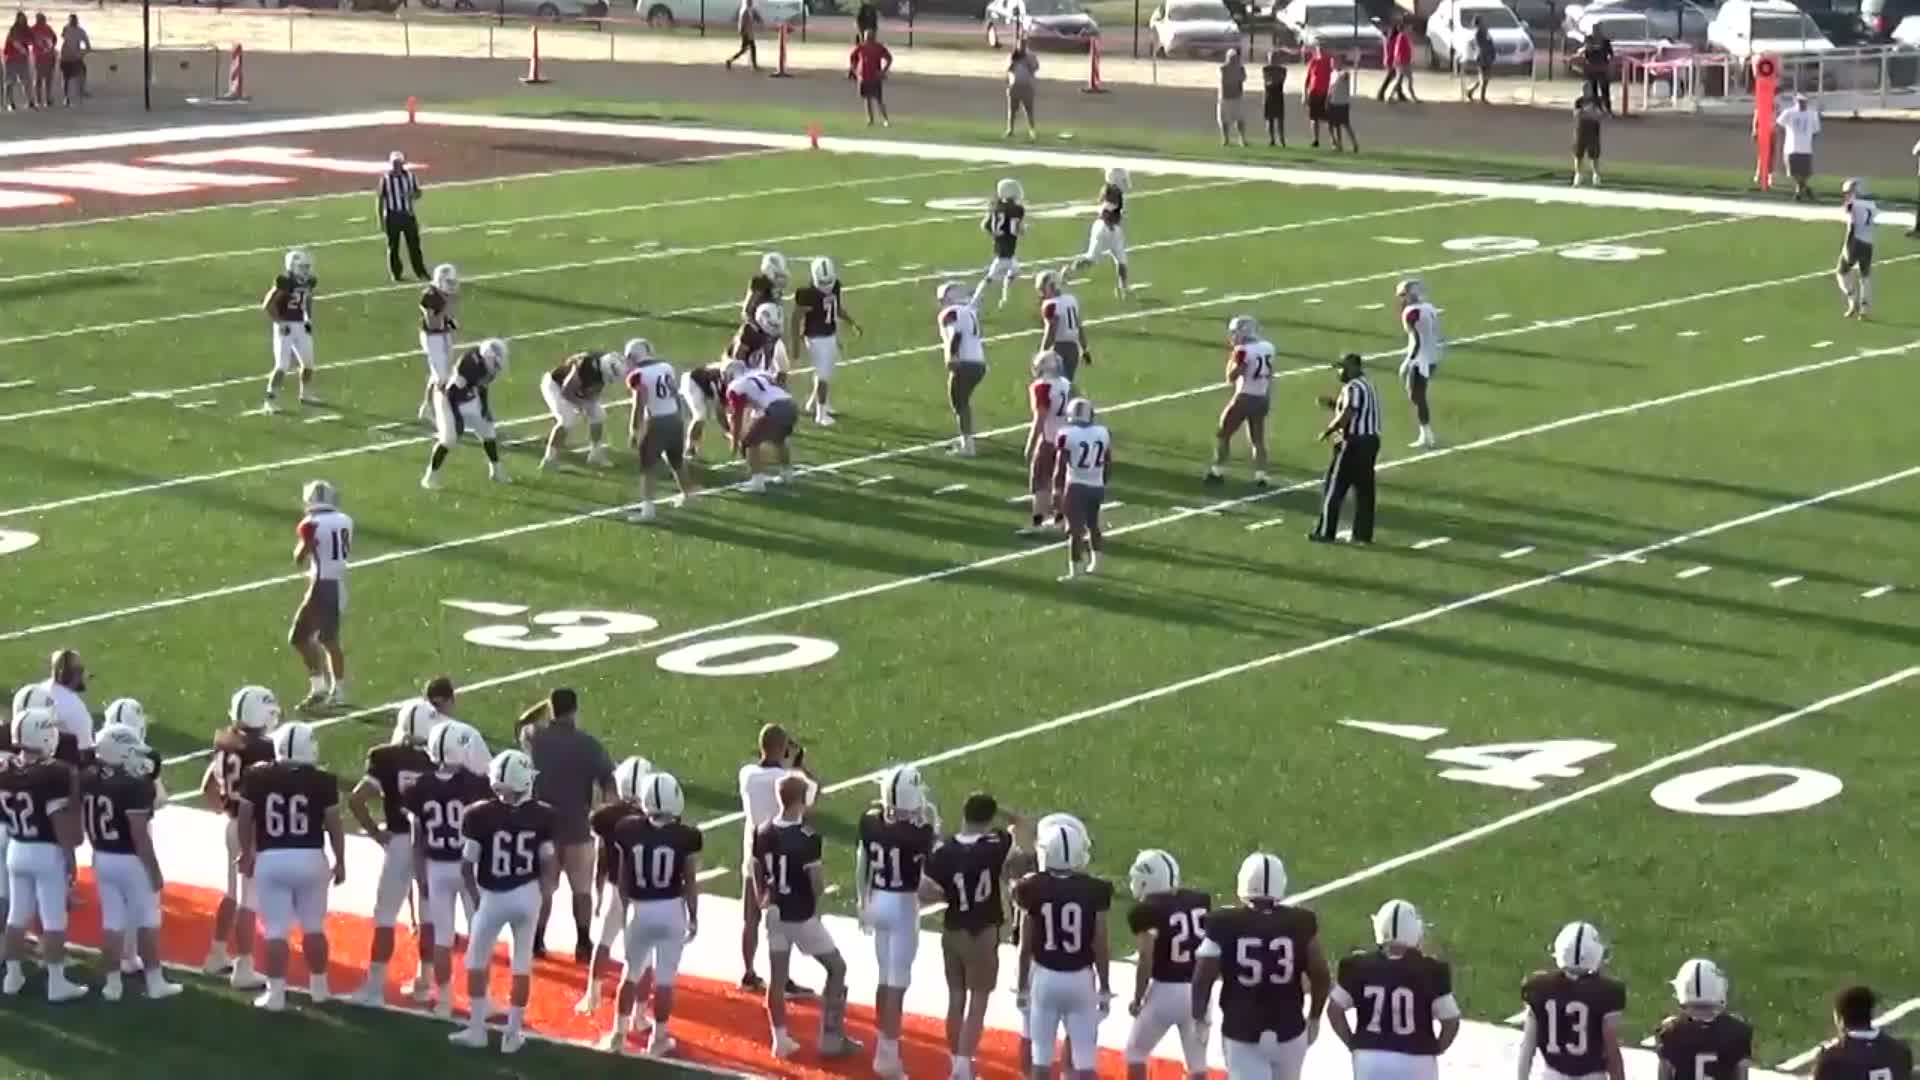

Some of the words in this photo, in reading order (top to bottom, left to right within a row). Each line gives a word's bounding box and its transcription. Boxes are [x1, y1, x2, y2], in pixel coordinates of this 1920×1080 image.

[1078, 440, 1104, 469] 22
[265, 792, 309, 837] 66
[423, 799, 466, 849] 29
[491, 830, 537, 877] 65
[632, 842, 675, 889] 10
[870, 842, 904, 888] 21
[1040, 901, 1083, 953] 19
[1236, 936, 1295, 987] 53
[1362, 985, 1417, 1035] 70
[1544, 998, 1590, 1056] 13
